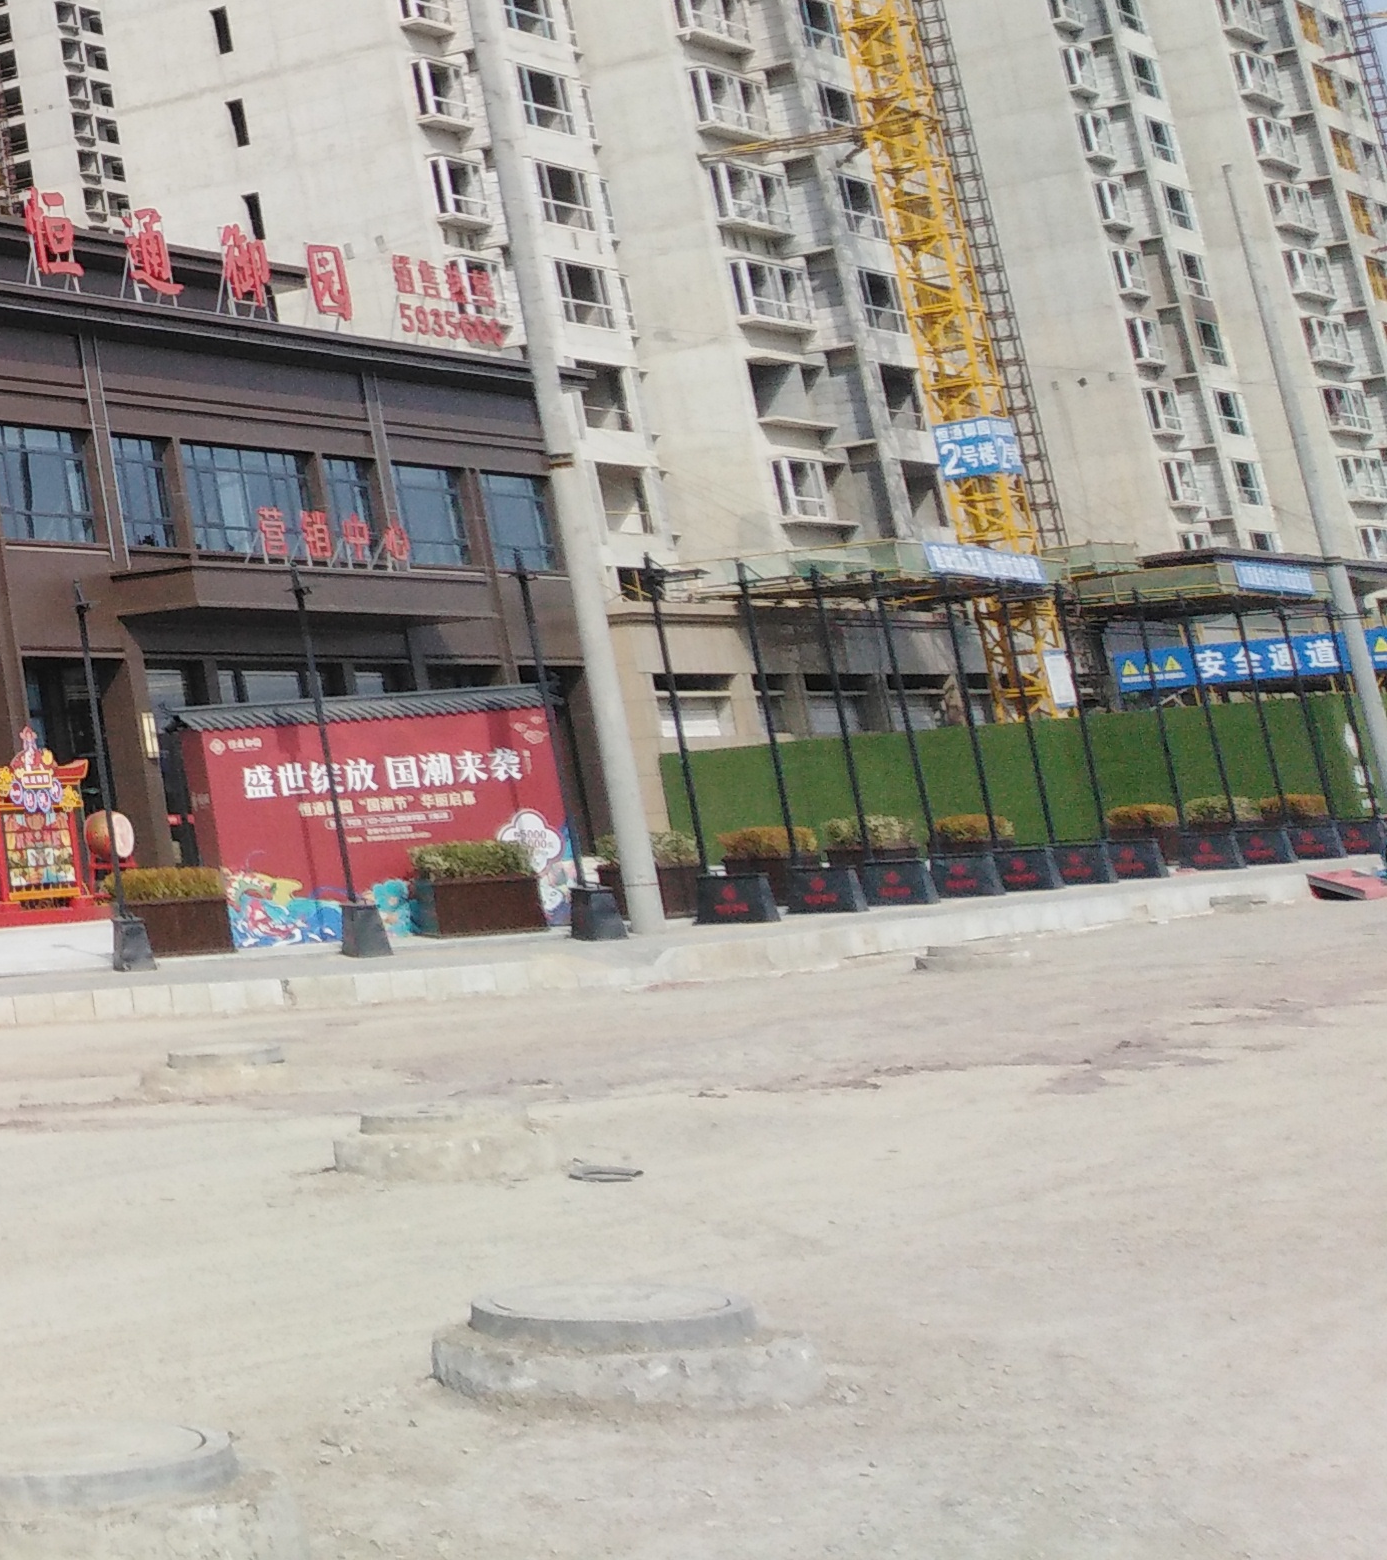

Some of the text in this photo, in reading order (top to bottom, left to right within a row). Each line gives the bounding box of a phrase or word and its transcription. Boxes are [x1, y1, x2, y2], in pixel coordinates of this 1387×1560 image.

[25, 186, 353, 321] 恒通御园
[399, 302, 504, 348] 5935666
[940, 441, 999, 476] 2号楼
[257, 505, 410, 561] 营销中心
[1195, 638, 1342, 679] 安全通道
[242, 758, 379, 800] 盛世绽放
[385, 747, 525, 790] 国潮来袭
